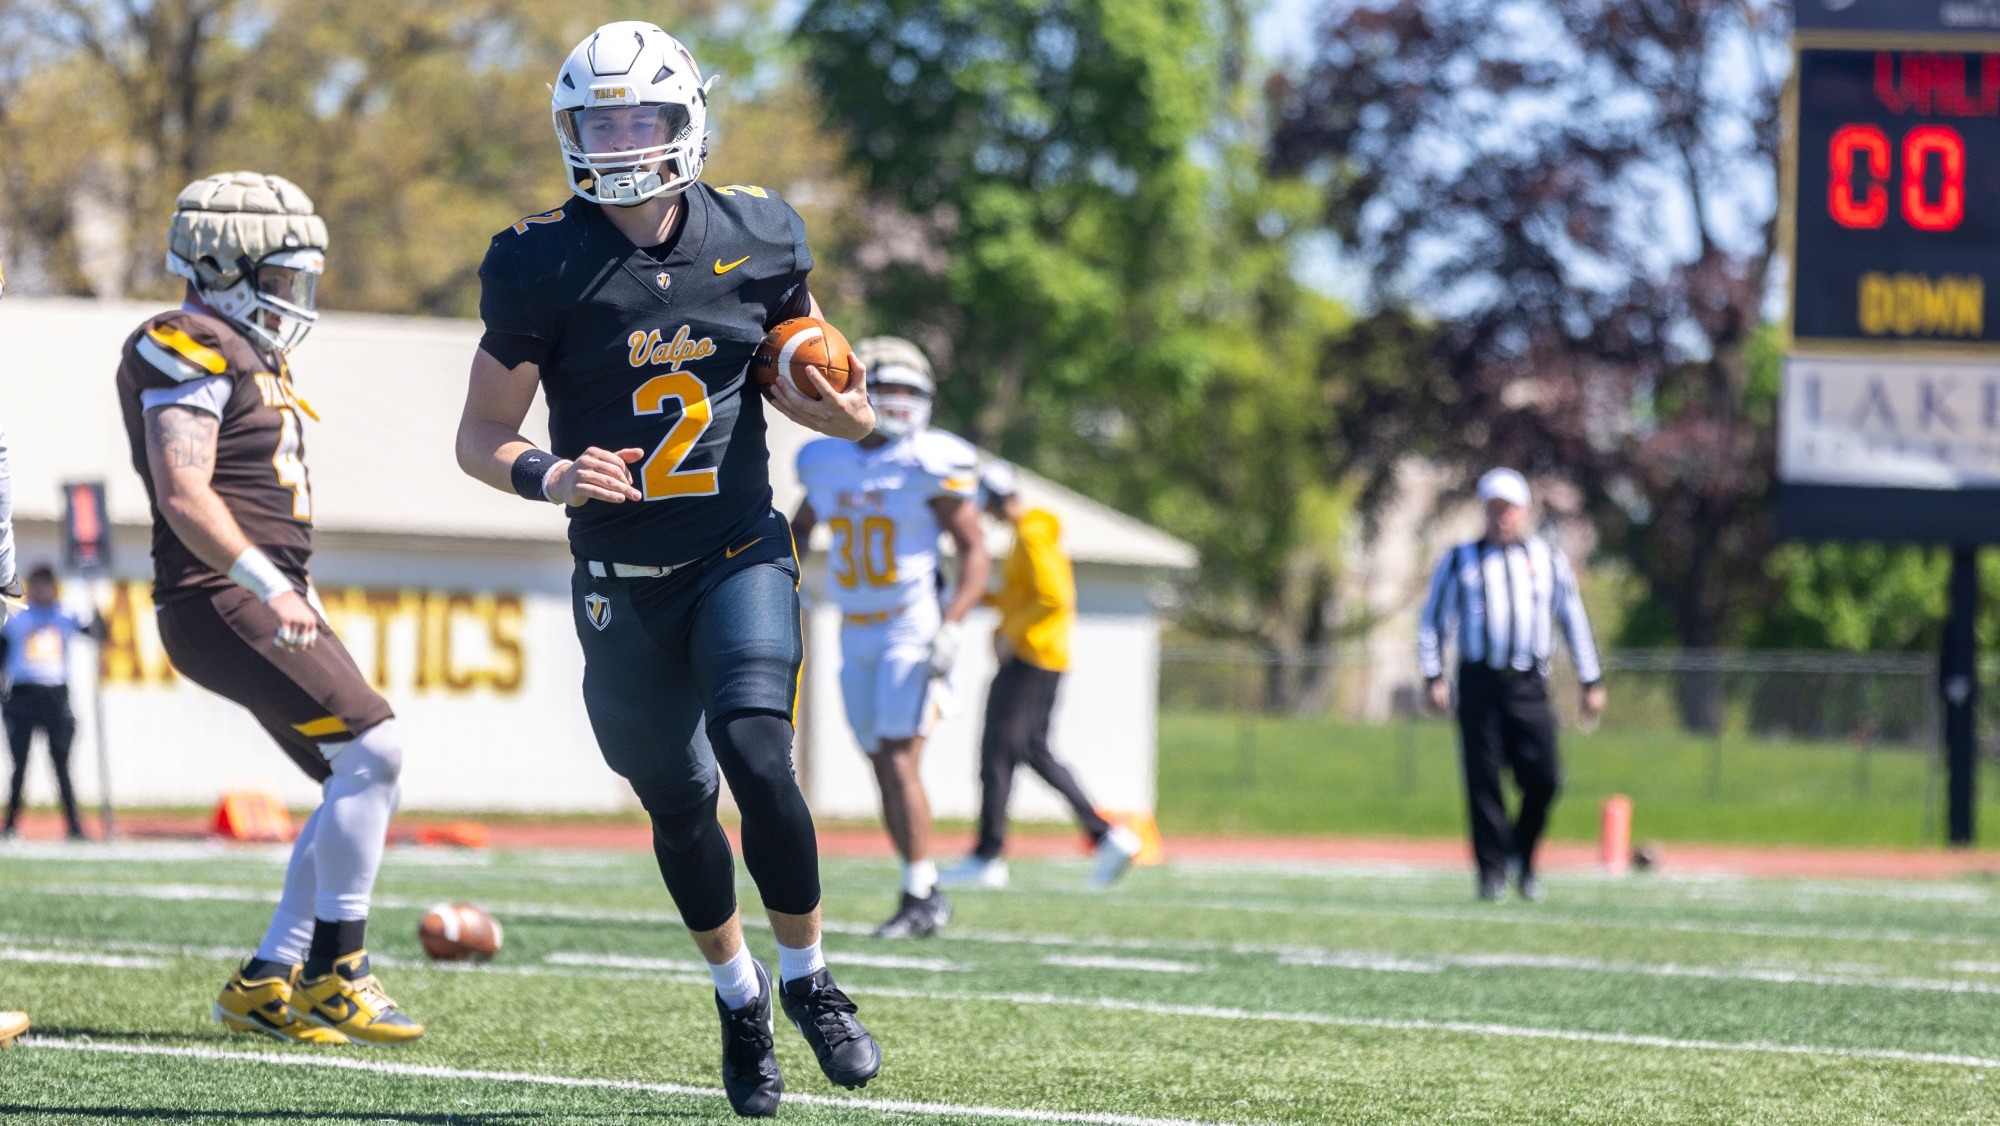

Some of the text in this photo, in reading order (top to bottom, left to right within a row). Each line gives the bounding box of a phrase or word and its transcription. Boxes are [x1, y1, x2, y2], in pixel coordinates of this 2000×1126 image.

[593, 87, 626, 100] VALPO
[512, 209, 566, 236] 2
[1857, 271, 1985, 336] DOWN
[628, 324, 716, 371] Valpo
[632, 370, 720, 502] 2
[828, 515, 899, 588] 30
